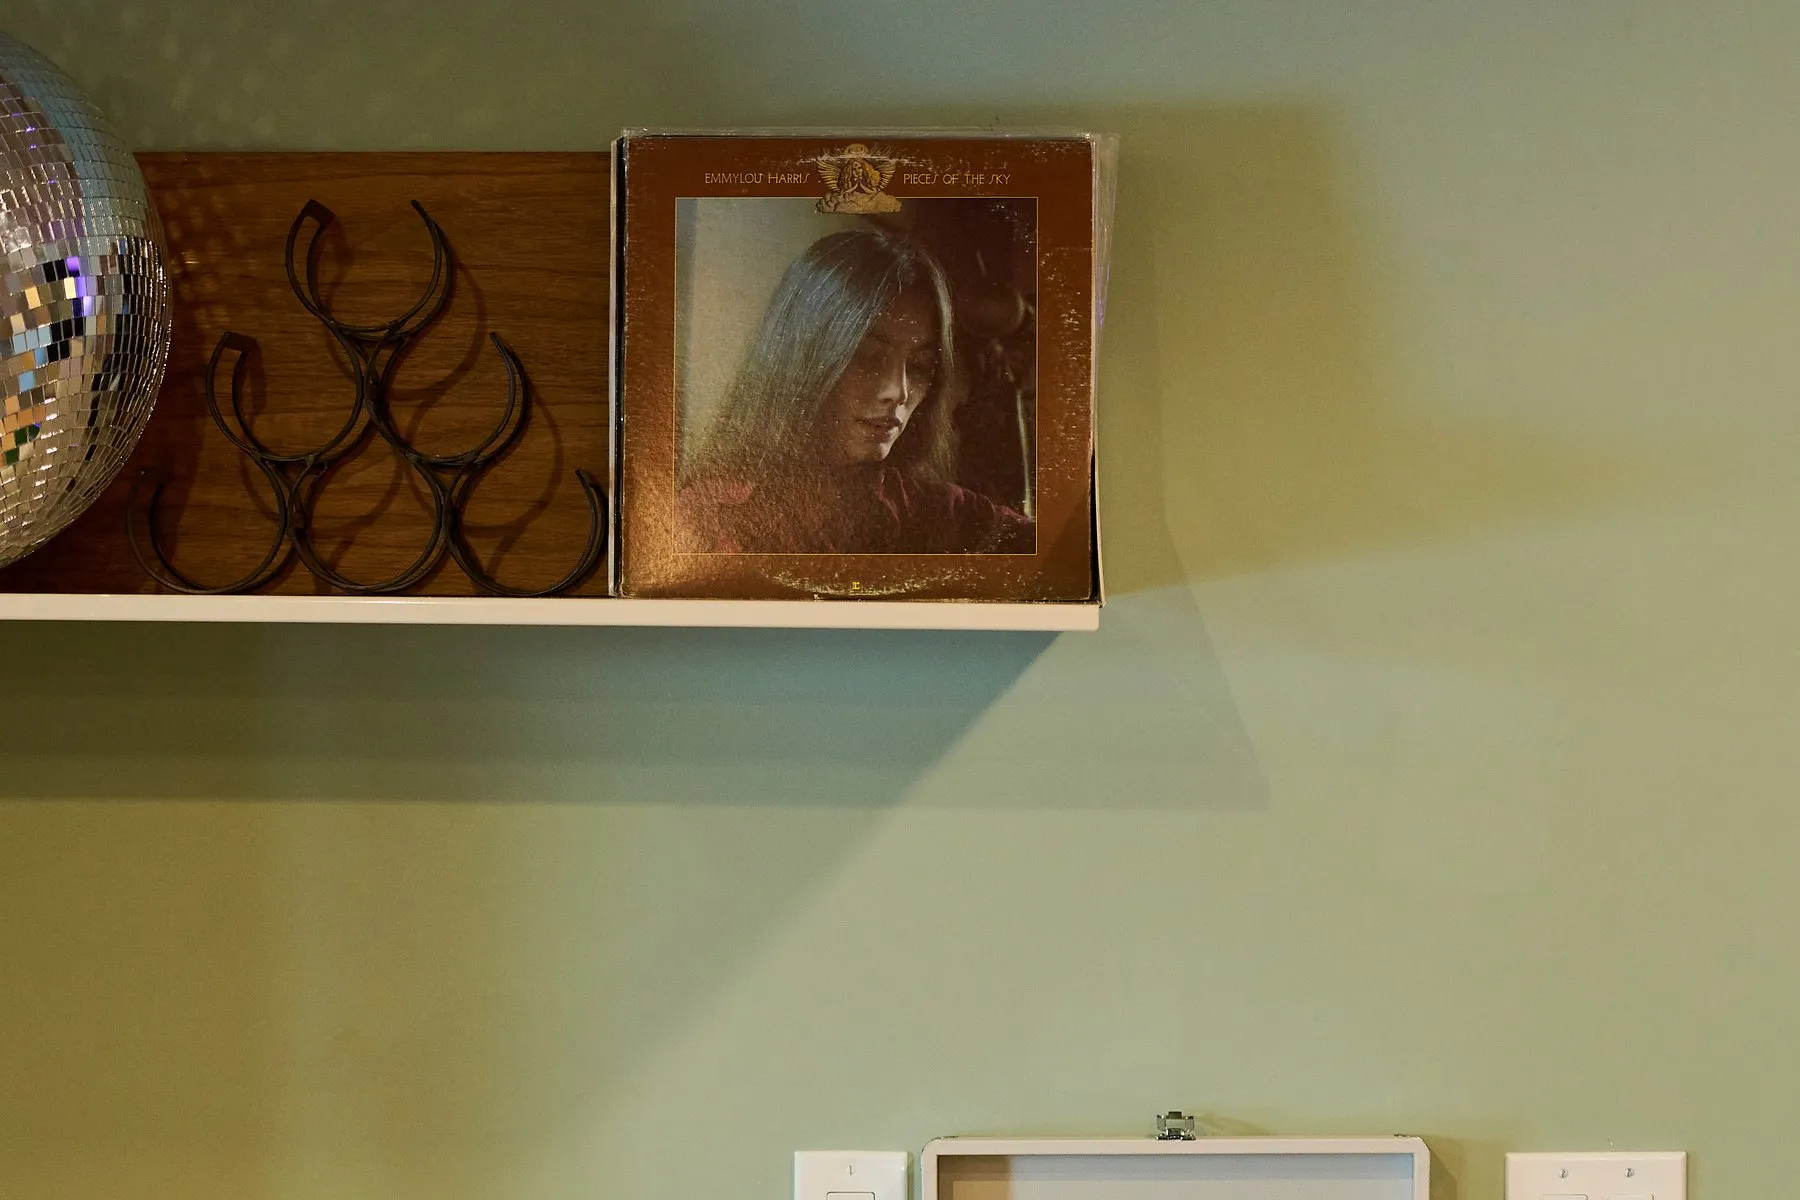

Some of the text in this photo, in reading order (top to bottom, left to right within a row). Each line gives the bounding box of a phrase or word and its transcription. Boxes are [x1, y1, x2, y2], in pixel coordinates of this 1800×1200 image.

[705, 172, 811, 184] EMMYLOU HARRIS
[903, 173, 1011, 185] PIECES OF THE SKY
